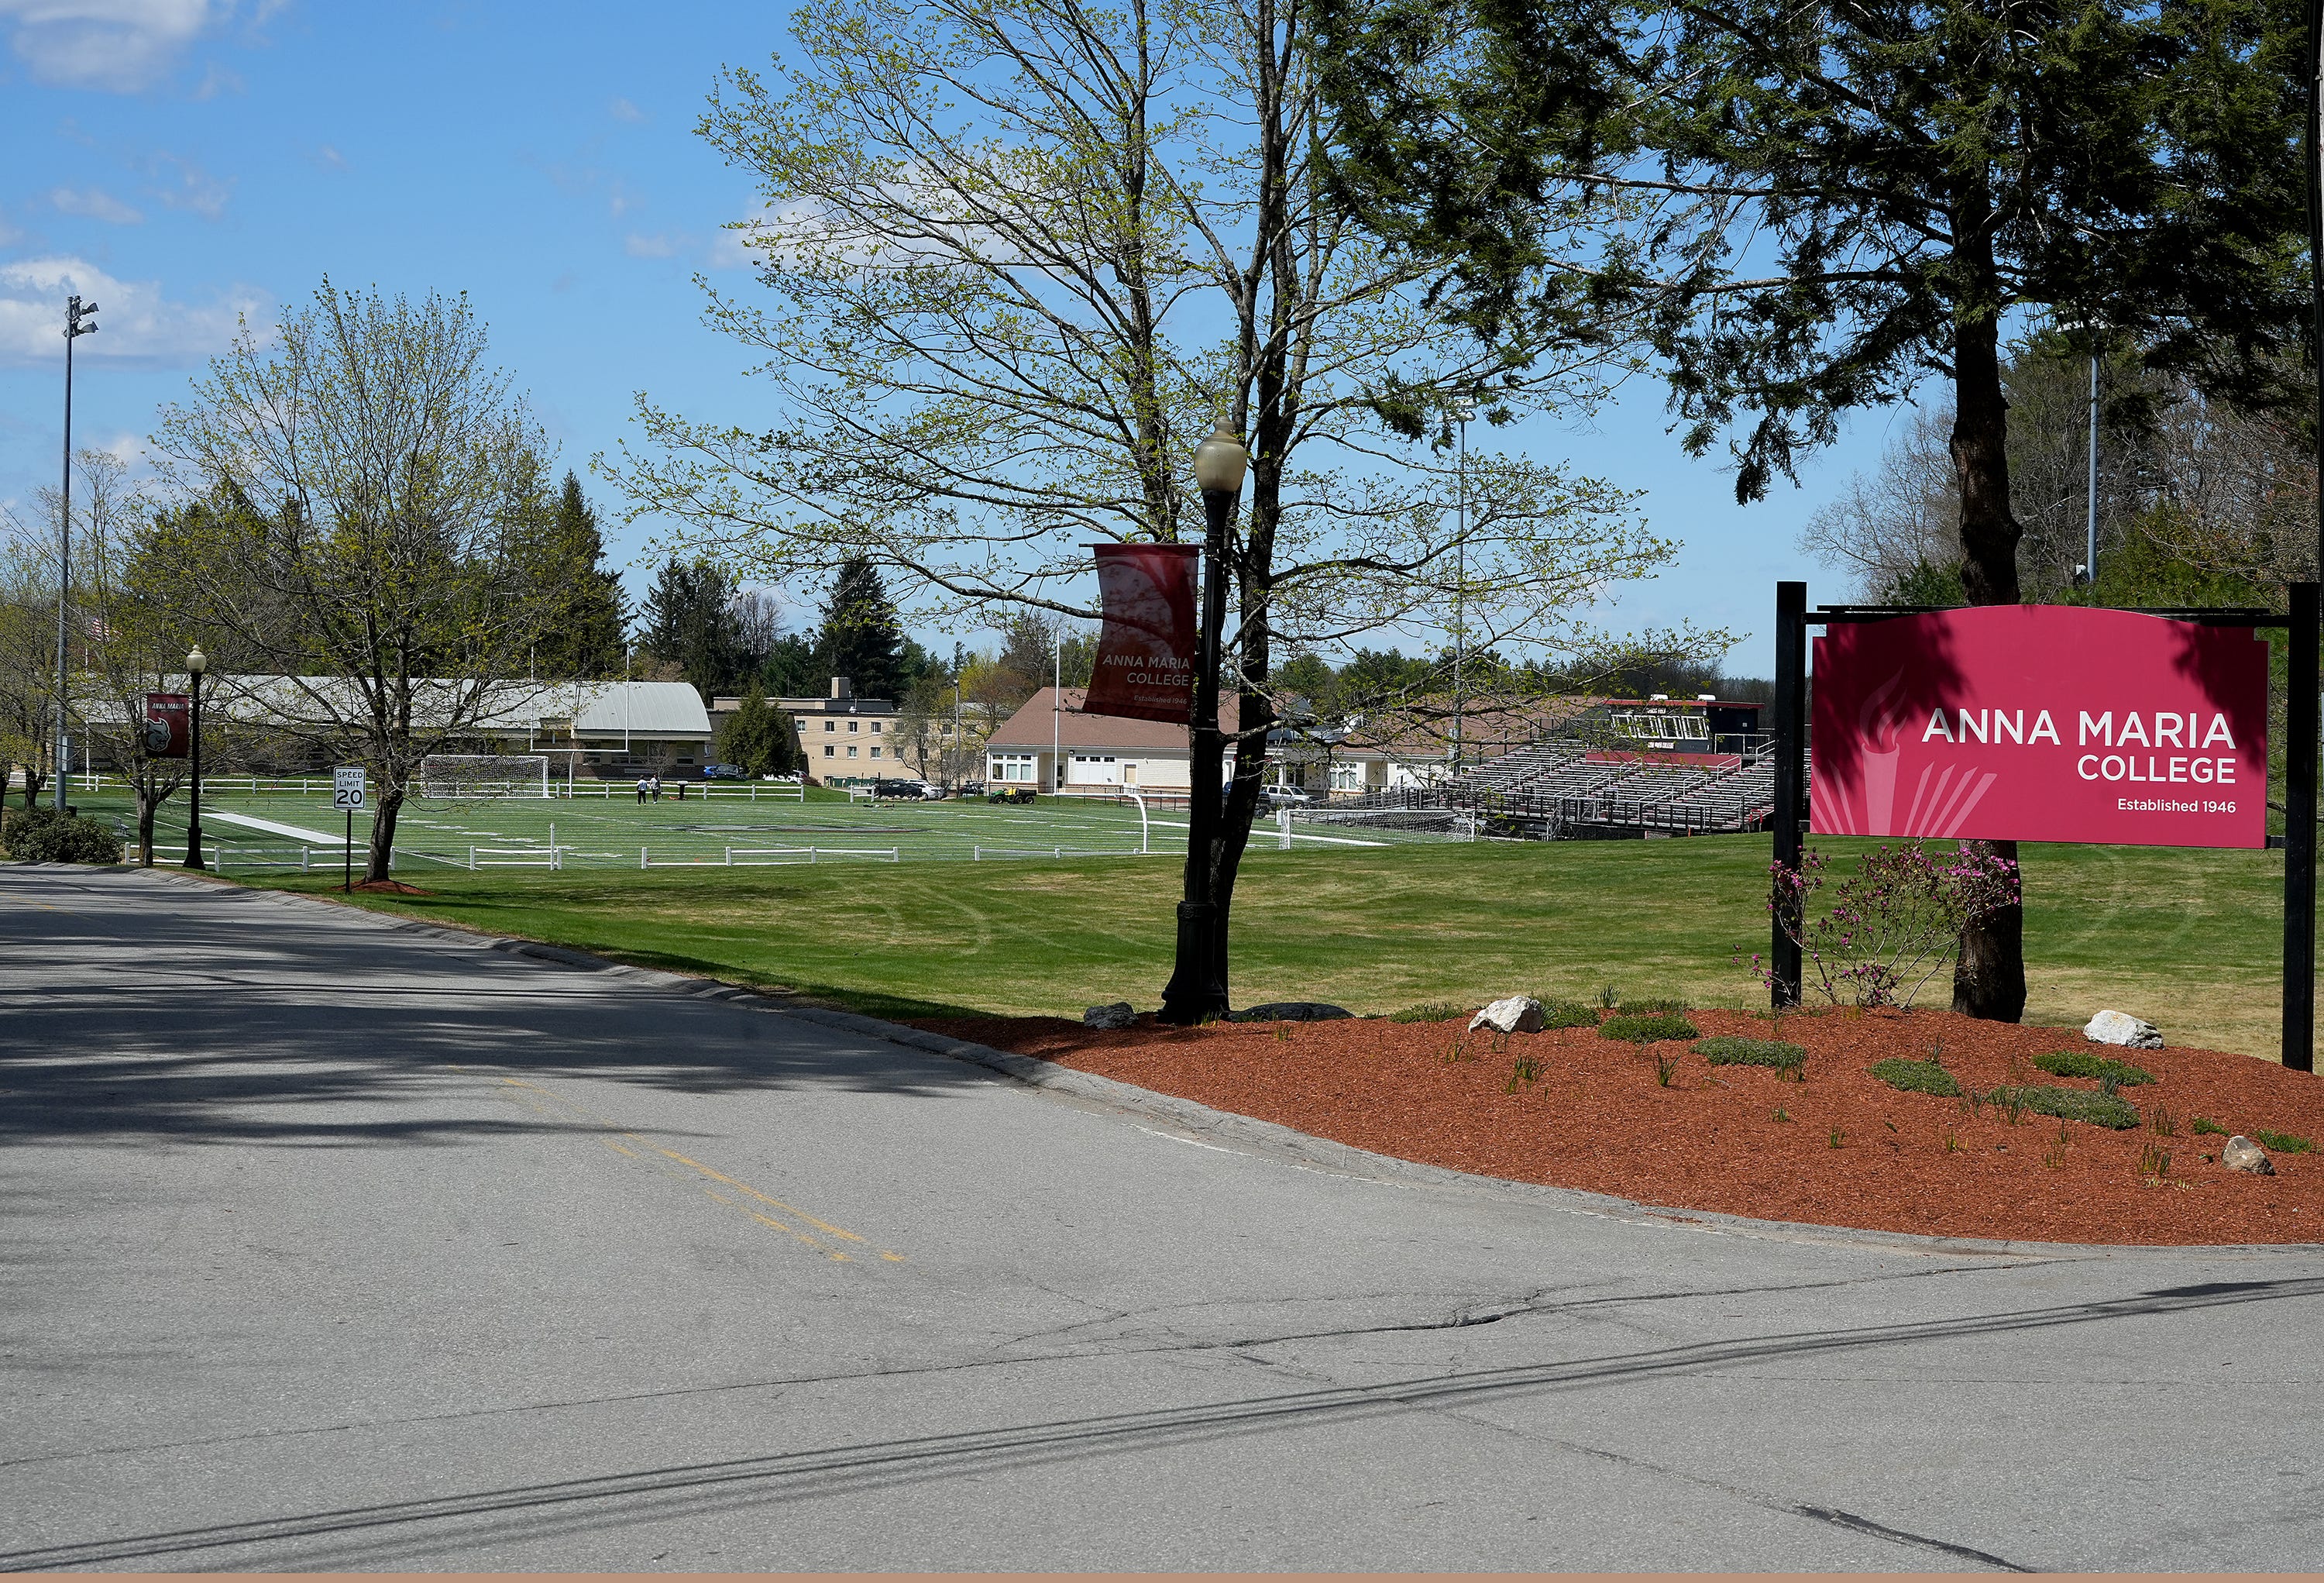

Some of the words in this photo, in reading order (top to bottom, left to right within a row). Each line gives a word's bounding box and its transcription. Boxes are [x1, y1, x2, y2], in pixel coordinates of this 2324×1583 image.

[1102, 654, 1143, 667] ANNA
[1148, 656, 1190, 669] MARIA
[1126, 672, 1189, 686] COLLEGE
[1133, 694, 1171, 704] Established
[1172, 697, 1188, 705] 1946
[1921, 707, 2061, 745] ANNA
[2078, 711, 2236, 749] MARIA
[2077, 754, 2236, 784] COLLEGE
[336, 790, 363, 804] 20
[2117, 798, 2199, 813] Established
[2202, 800, 2236, 814] 1946
